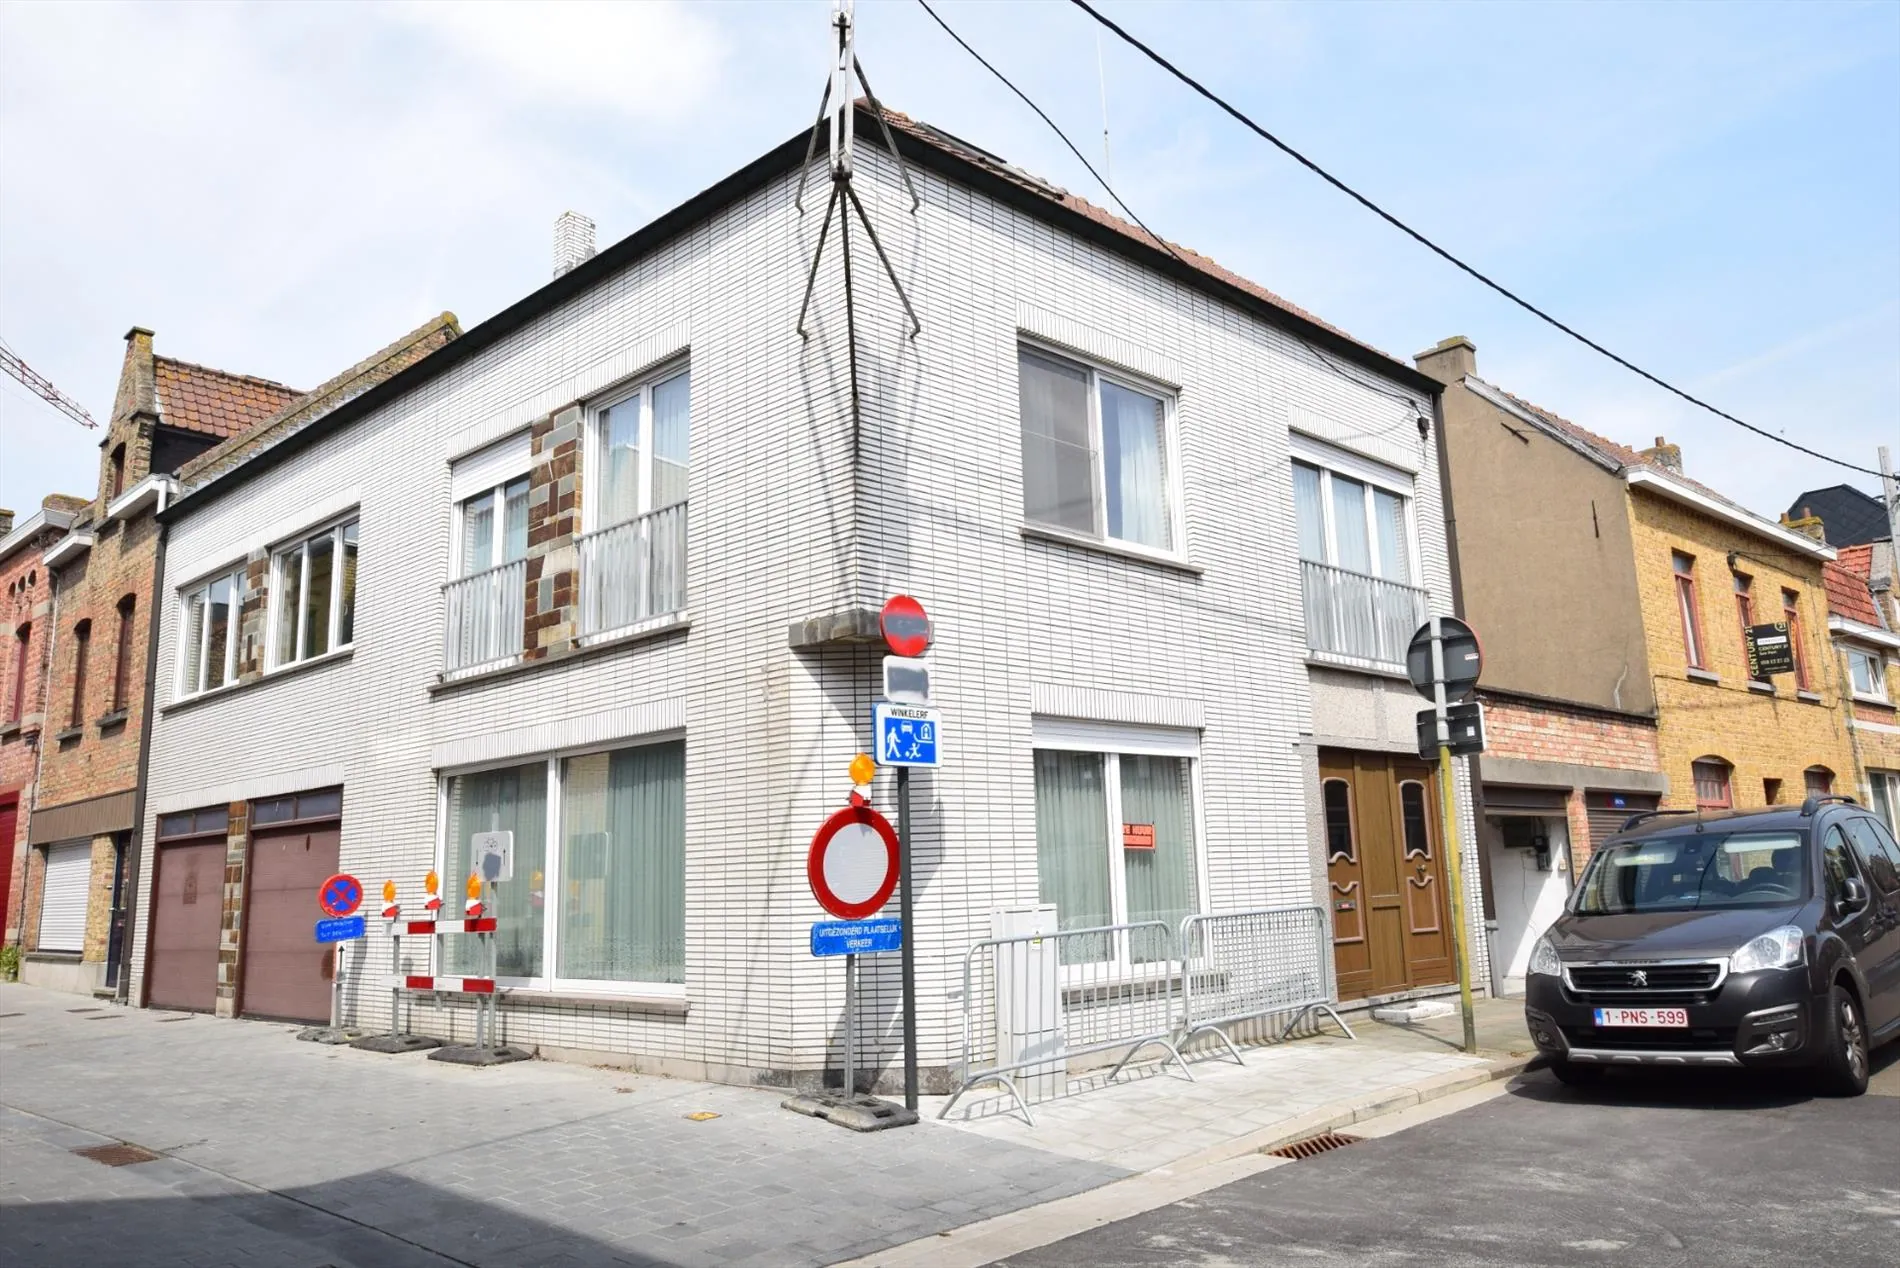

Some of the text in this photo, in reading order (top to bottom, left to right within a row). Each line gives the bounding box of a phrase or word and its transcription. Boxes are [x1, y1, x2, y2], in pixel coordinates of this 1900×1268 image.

[1745, 636, 1759, 676] CENTURY
[890, 707, 929, 719] WINKELERF
[819, 924, 898, 937] UITGEZONDERD PLAATSELIJK
[846, 938, 873, 948] VERKEER
